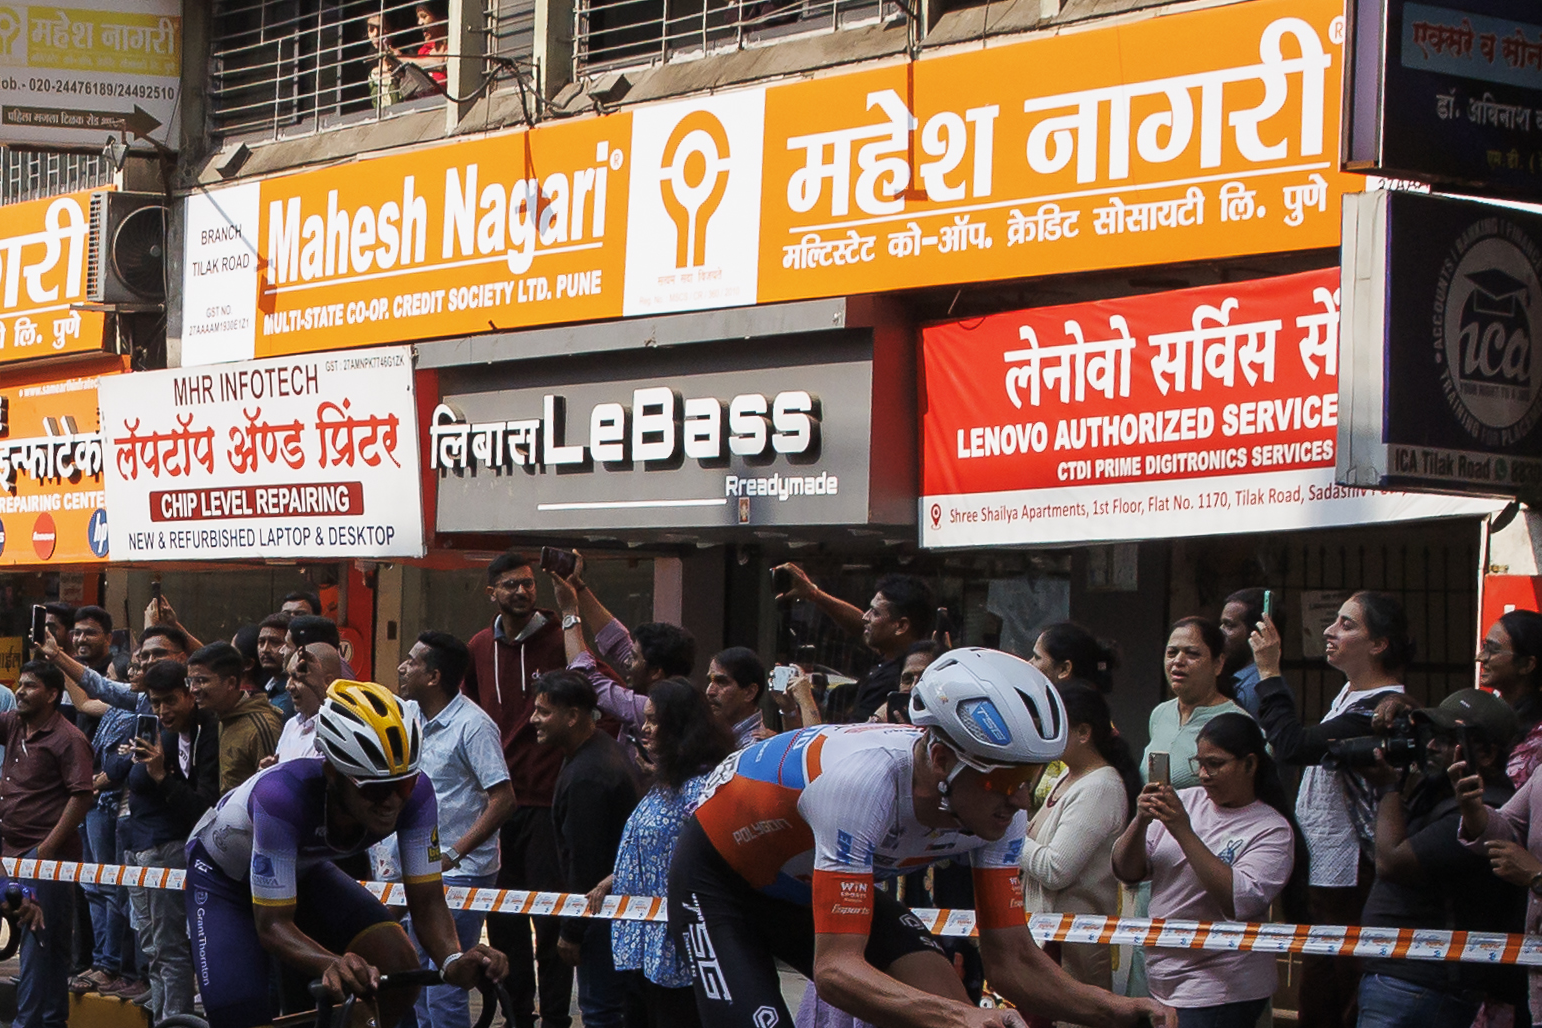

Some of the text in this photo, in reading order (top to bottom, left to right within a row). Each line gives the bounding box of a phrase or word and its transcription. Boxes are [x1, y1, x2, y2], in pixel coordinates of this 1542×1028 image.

[32, 10, 175, 54] महेश नागरी
[786, 17, 1332, 218] महेश नागरी
[200, 223, 242, 246] BRANCH
[266, 140, 609, 287] Mahesh Nagari
[781, 222, 877, 271] मल्टिस्टेट
[1005, 204, 1081, 248] क्रेडिट
[1092, 185, 1205, 236] सोसायटी
[1219, 181, 1267, 222] लि.
[1282, 173, 1330, 227] पुणे
[192, 253, 250, 277] TILAK ROAD
[206, 306, 219, 319] GST
[263, 268, 603, 337] MULTI-STATE CO-OP. CREDIT SOCIETY LTD. PUNE
[14, 316, 43, 349] लि.
[51, 311, 82, 351] पुणे
[1002, 296, 1284, 411] लेनोवो सर्विस
[173, 364, 319, 407] MHR INFOTECH
[113, 412, 216, 481] लॅपटॉप
[315, 396, 402, 469] प्रिंटर
[429, 402, 541, 470] लिबास
[543, 386, 814, 466] LeBass
[956, 392, 1339, 460] LENOVO AUTHORIZED SERVICE
[1056, 439, 1334, 482] CTDI PRIME DIGITRONICS SERVICES
[1394, 448, 1491, 482] ICA Tilak Road
[63, 491, 106, 511] CENTE
[160, 484, 351, 519] CHIP LEVEL REPAIRING
[949, 484, 1305, 526] Shree Shailya Apartments, 1st Floor, Flat No. 1170, Tilak Road,
[93, 512, 108, 554] hp
[128, 524, 396, 551] NEW & REFURBISHED LAPTOP & DESKTOP
[731, 818, 794, 846] POLYGON
[196, 907, 210, 986] Grant Thornton
